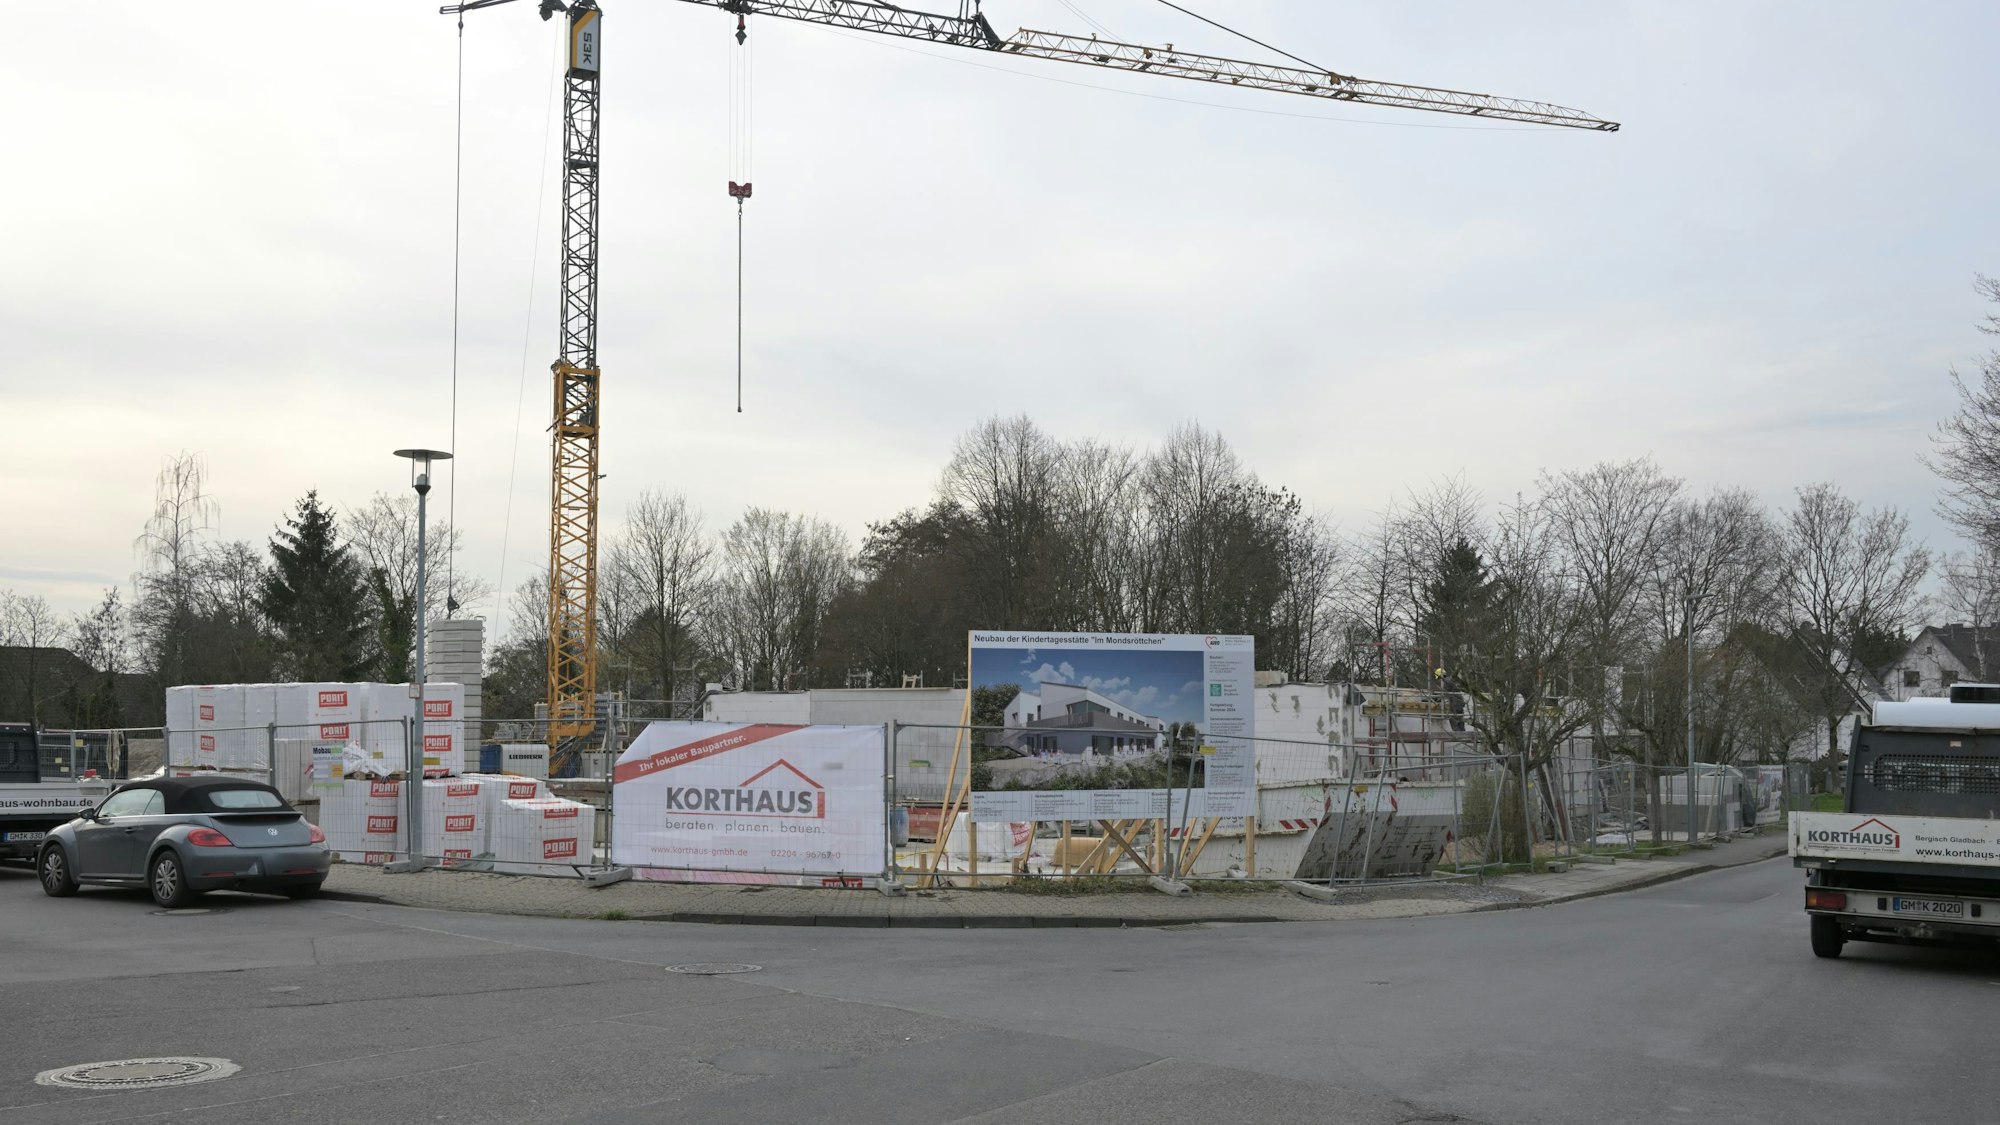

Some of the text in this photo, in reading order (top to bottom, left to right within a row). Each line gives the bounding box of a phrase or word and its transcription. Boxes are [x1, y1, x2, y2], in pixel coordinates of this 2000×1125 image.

[974, 634, 1005, 643] Neubau
[1007, 635, 1020, 643] der
[1021, 635, 1089, 645] Kindertagesstätte
[1106, 636, 1166, 645] Mondsröttchen"
[320, 693, 345, 703] PORIT
[425, 703, 449, 713] PORIT
[322, 727, 347, 736] PORIT
[425, 737, 449, 747] PORIT
[639, 734, 747, 772] Ihr lokaler Baupartner.
[372, 783, 398, 792] PORIT
[510, 785, 535, 795] PORIT
[666, 787, 813, 814] KORTHAUS
[369, 818, 395, 828] PORIT
[446, 818, 473, 827] PORIT
[665, 817, 826, 834] beraten. planen. bauen.
[1808, 830, 1893, 846] KORTHAUS
[1915, 834, 1948, 843] Bergisch
[1949, 836, 1986, 844] Gladbach
[544, 841, 575, 853] PORIT
[650, 846, 748, 857] www.korthaus-gmbh.de
[770, 849, 797, 857] 02204
[805, 851, 841, 860] 96767-0
[1915, 848, 2000, 860] www.korthaus-
[1900, 900, 1961, 914] GM K 2020
